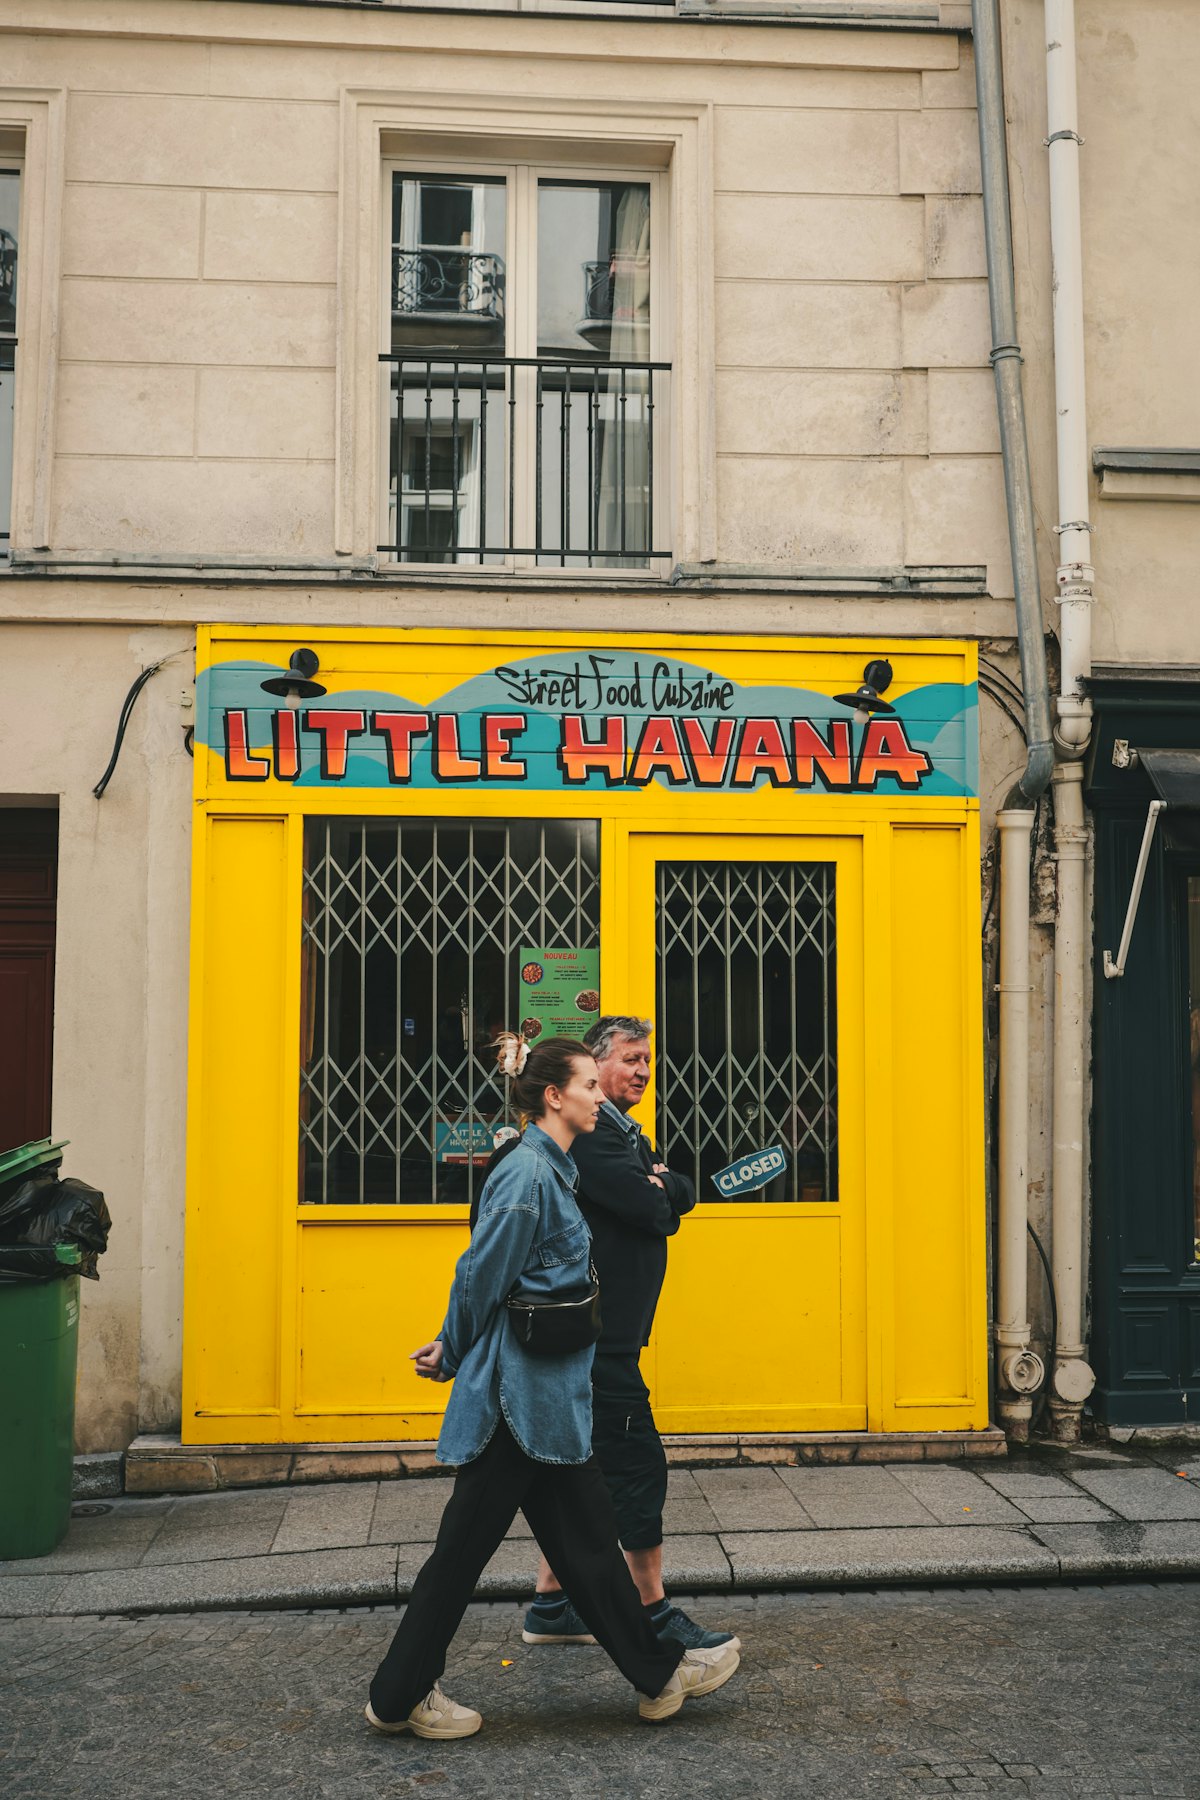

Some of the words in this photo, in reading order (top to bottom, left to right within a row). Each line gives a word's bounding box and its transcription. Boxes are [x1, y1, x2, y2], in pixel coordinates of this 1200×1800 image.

[495, 662, 587, 709] Street
[588, 655, 648, 710] Food
[223, 708, 527, 784] LITTLE
[556, 713, 934, 792] HAVANA
[544, 952, 578, 960] NOUVEAU
[719, 1152, 783, 1190] CLOSED
